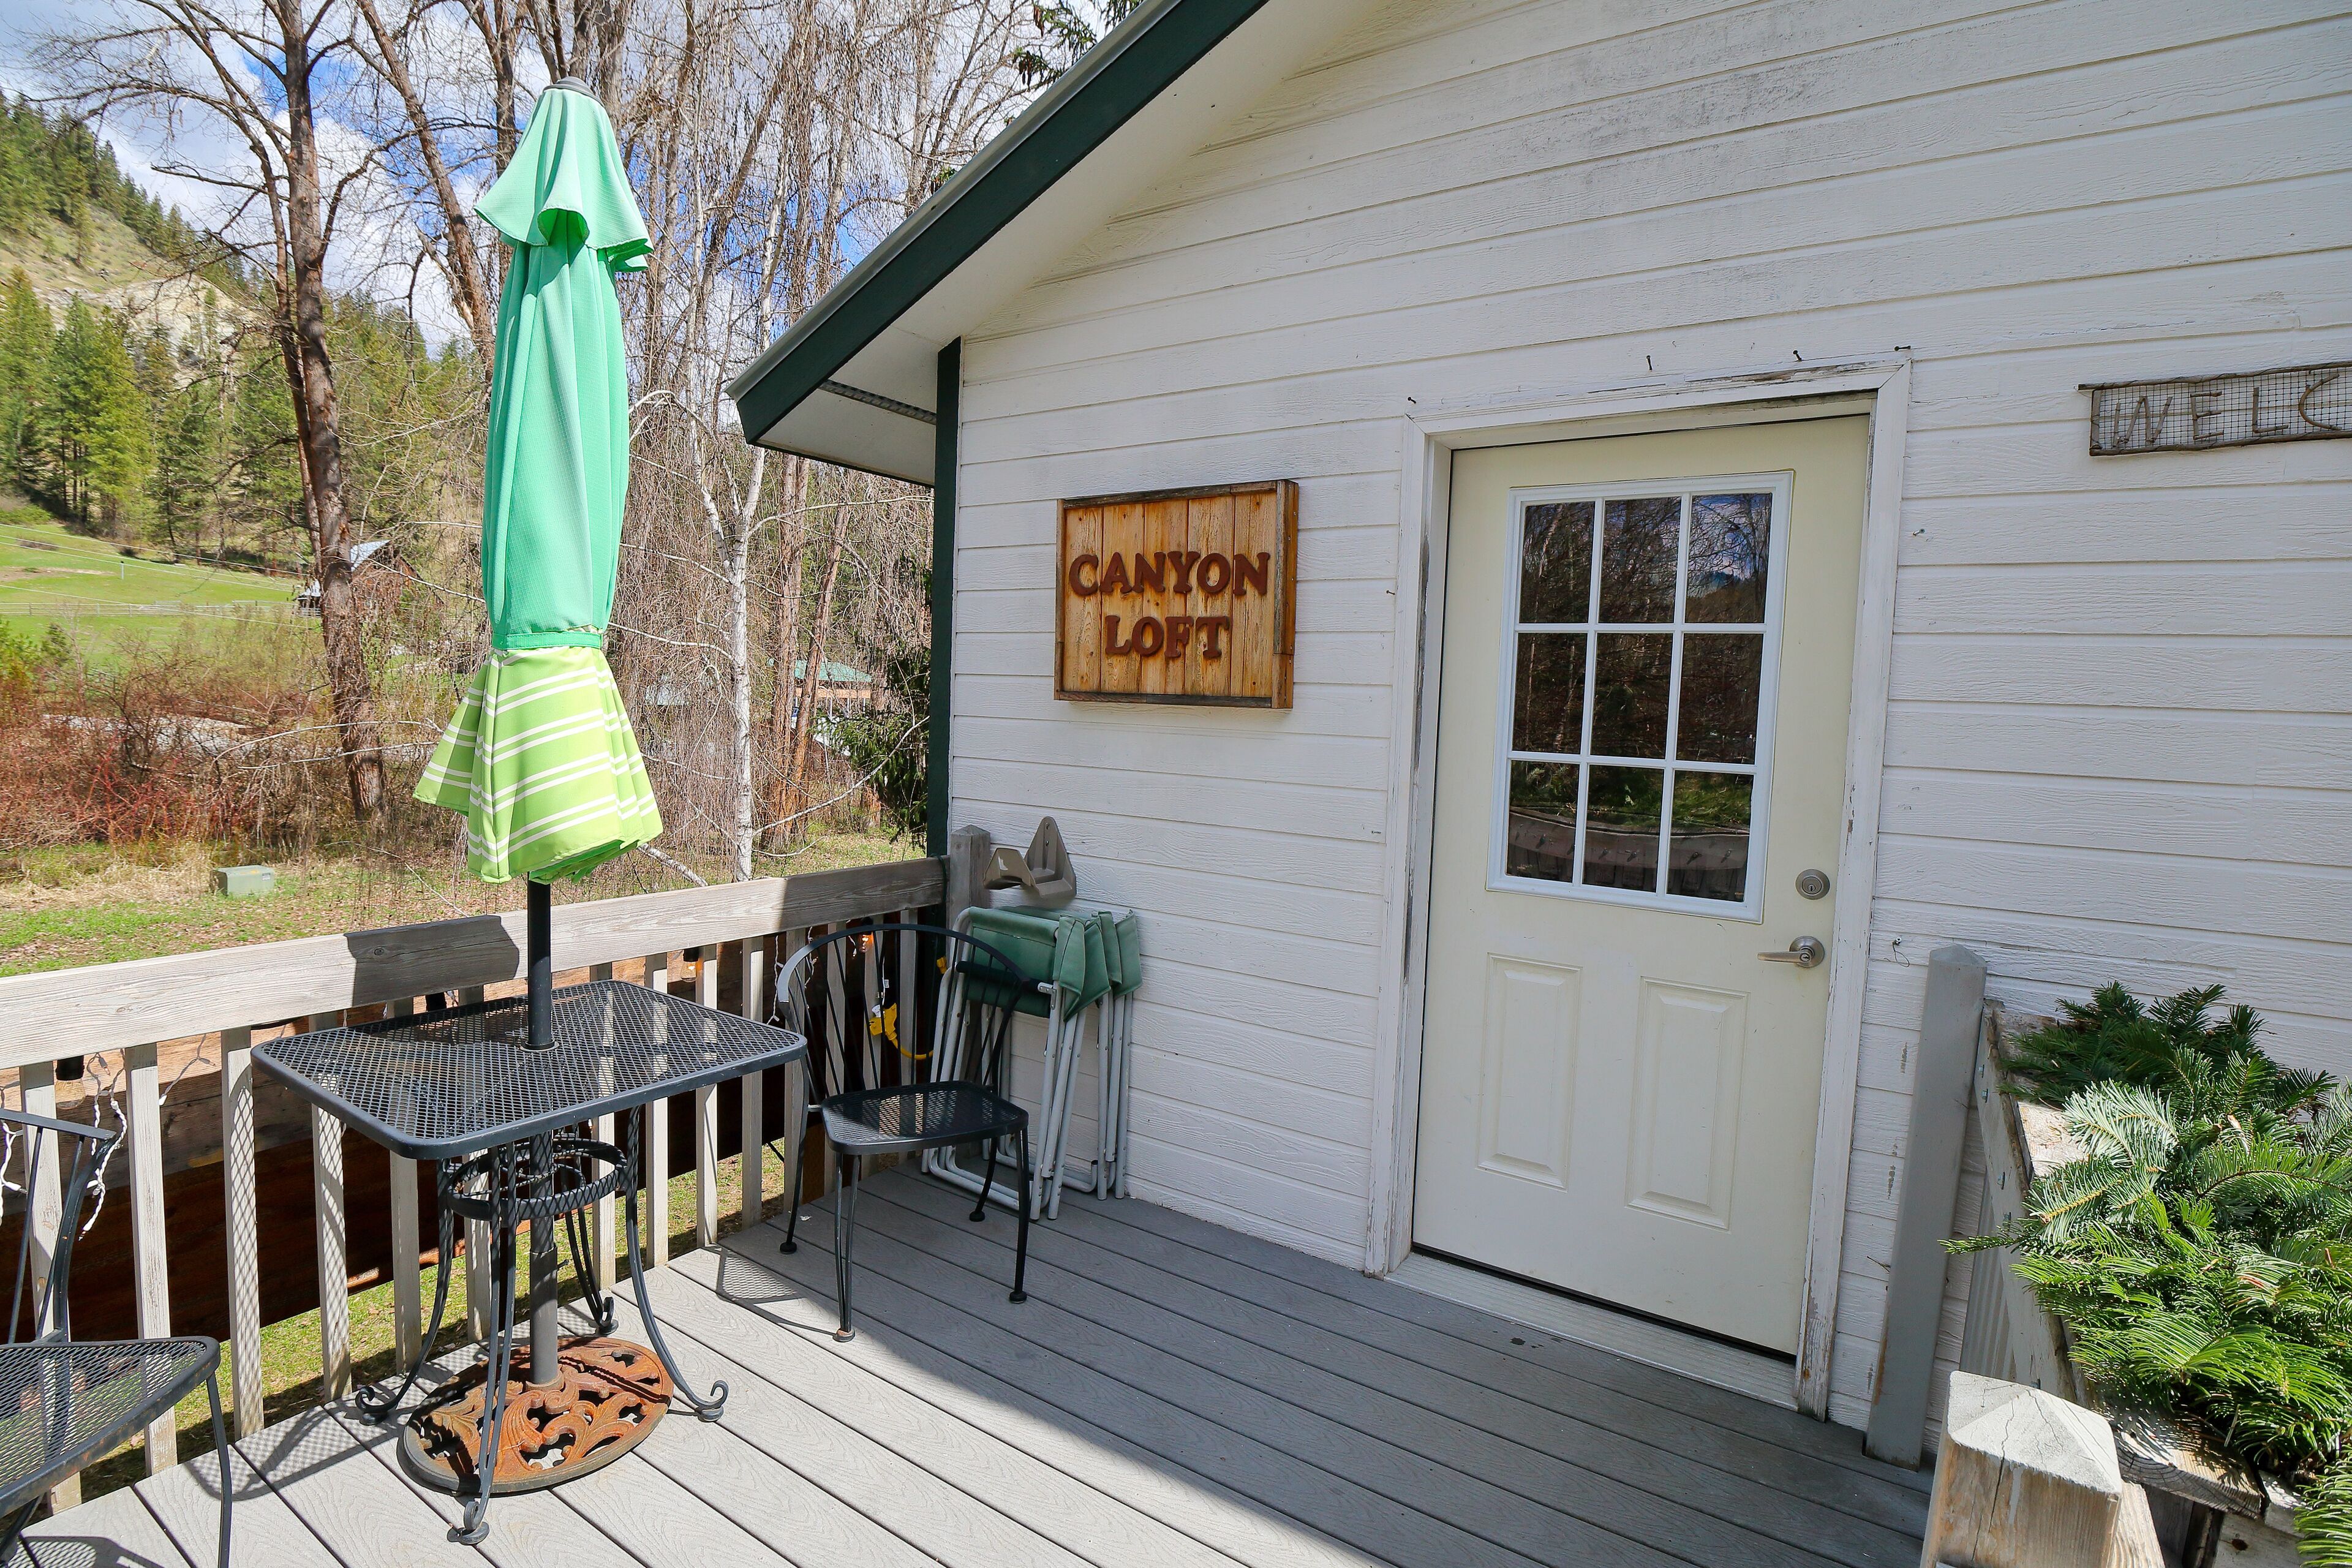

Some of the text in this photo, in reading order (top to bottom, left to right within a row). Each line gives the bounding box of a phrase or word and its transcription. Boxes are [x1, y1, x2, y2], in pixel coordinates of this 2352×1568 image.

[2113, 372, 2343, 448] WELC
[1069, 551, 1270, 597] CANYON
[1105, 615, 1229, 658] LOFT
